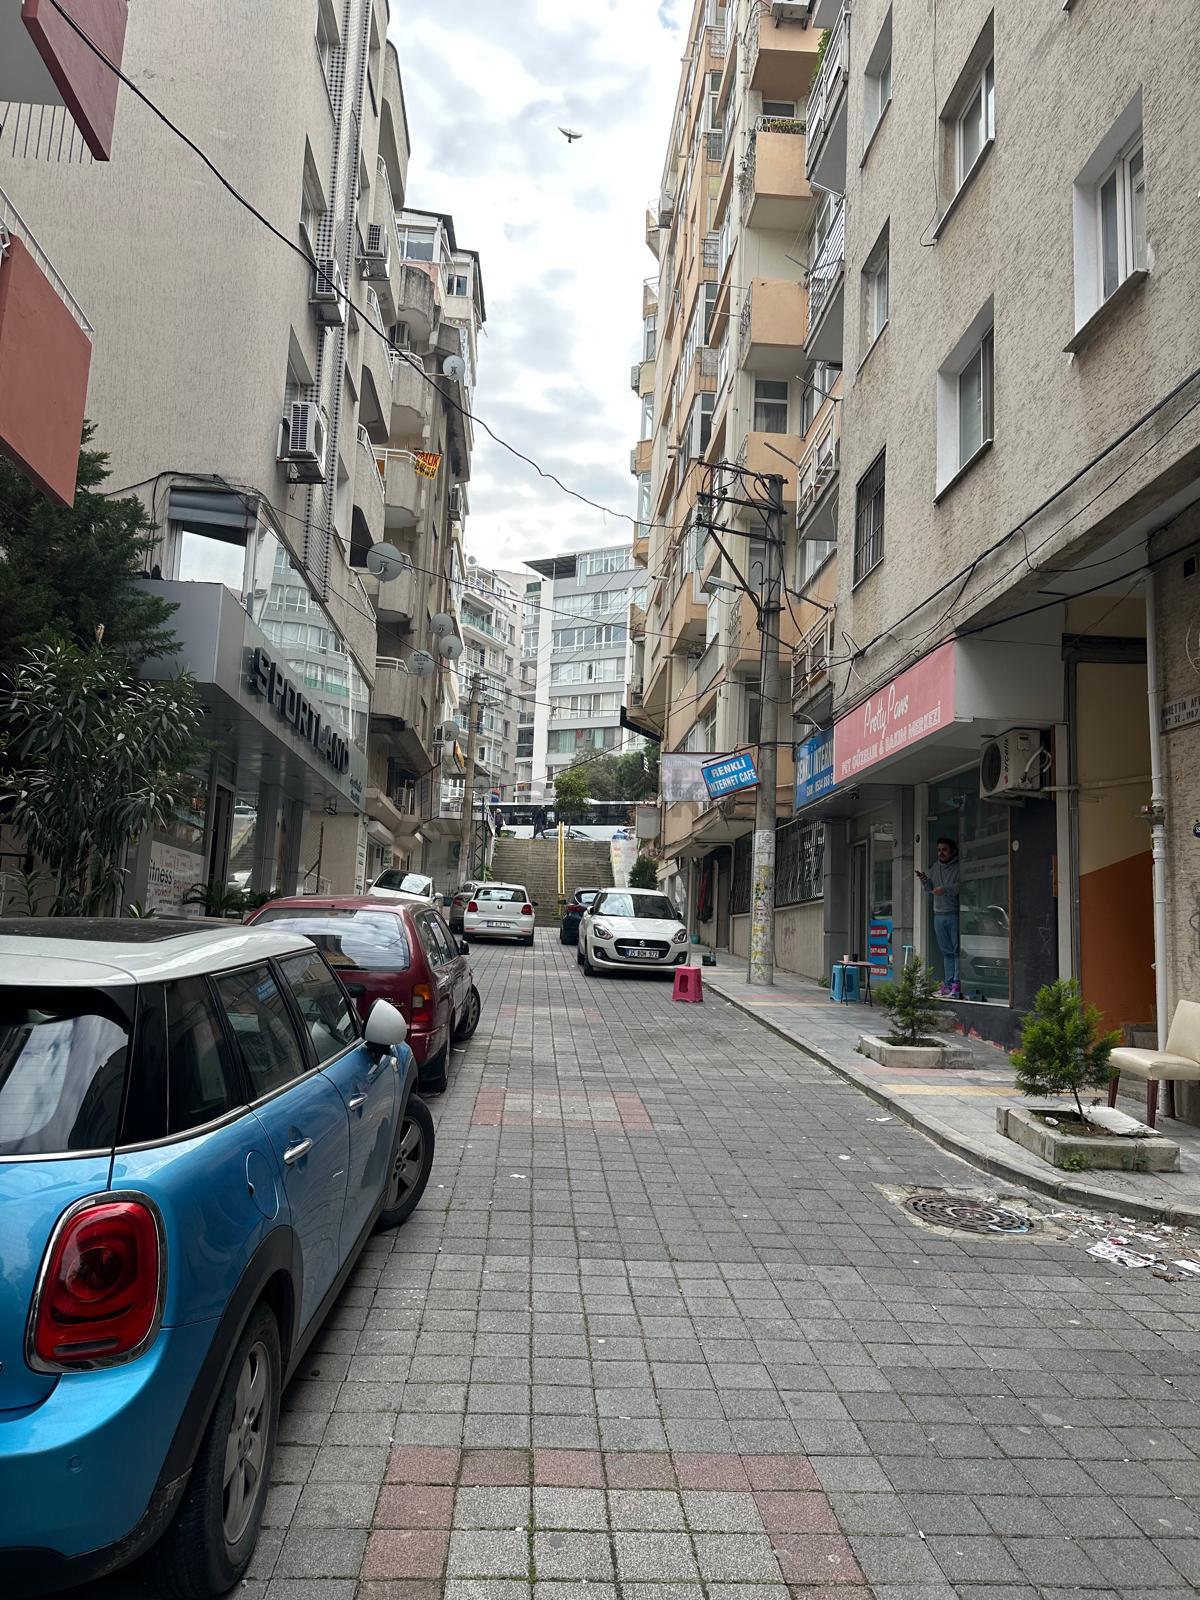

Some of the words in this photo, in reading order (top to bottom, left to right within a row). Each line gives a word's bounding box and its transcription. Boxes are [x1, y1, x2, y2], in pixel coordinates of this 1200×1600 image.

[864, 697, 887, 740] Pretty
[887, 683, 909, 724] Paws
[841, 759, 851, 776] PET
[885, 727, 907, 753] BAKIM
[908, 700, 941, 740] MERKEZİ
[710, 757, 746, 778] RENKLİ
[739, 768, 757, 783] CAFE
